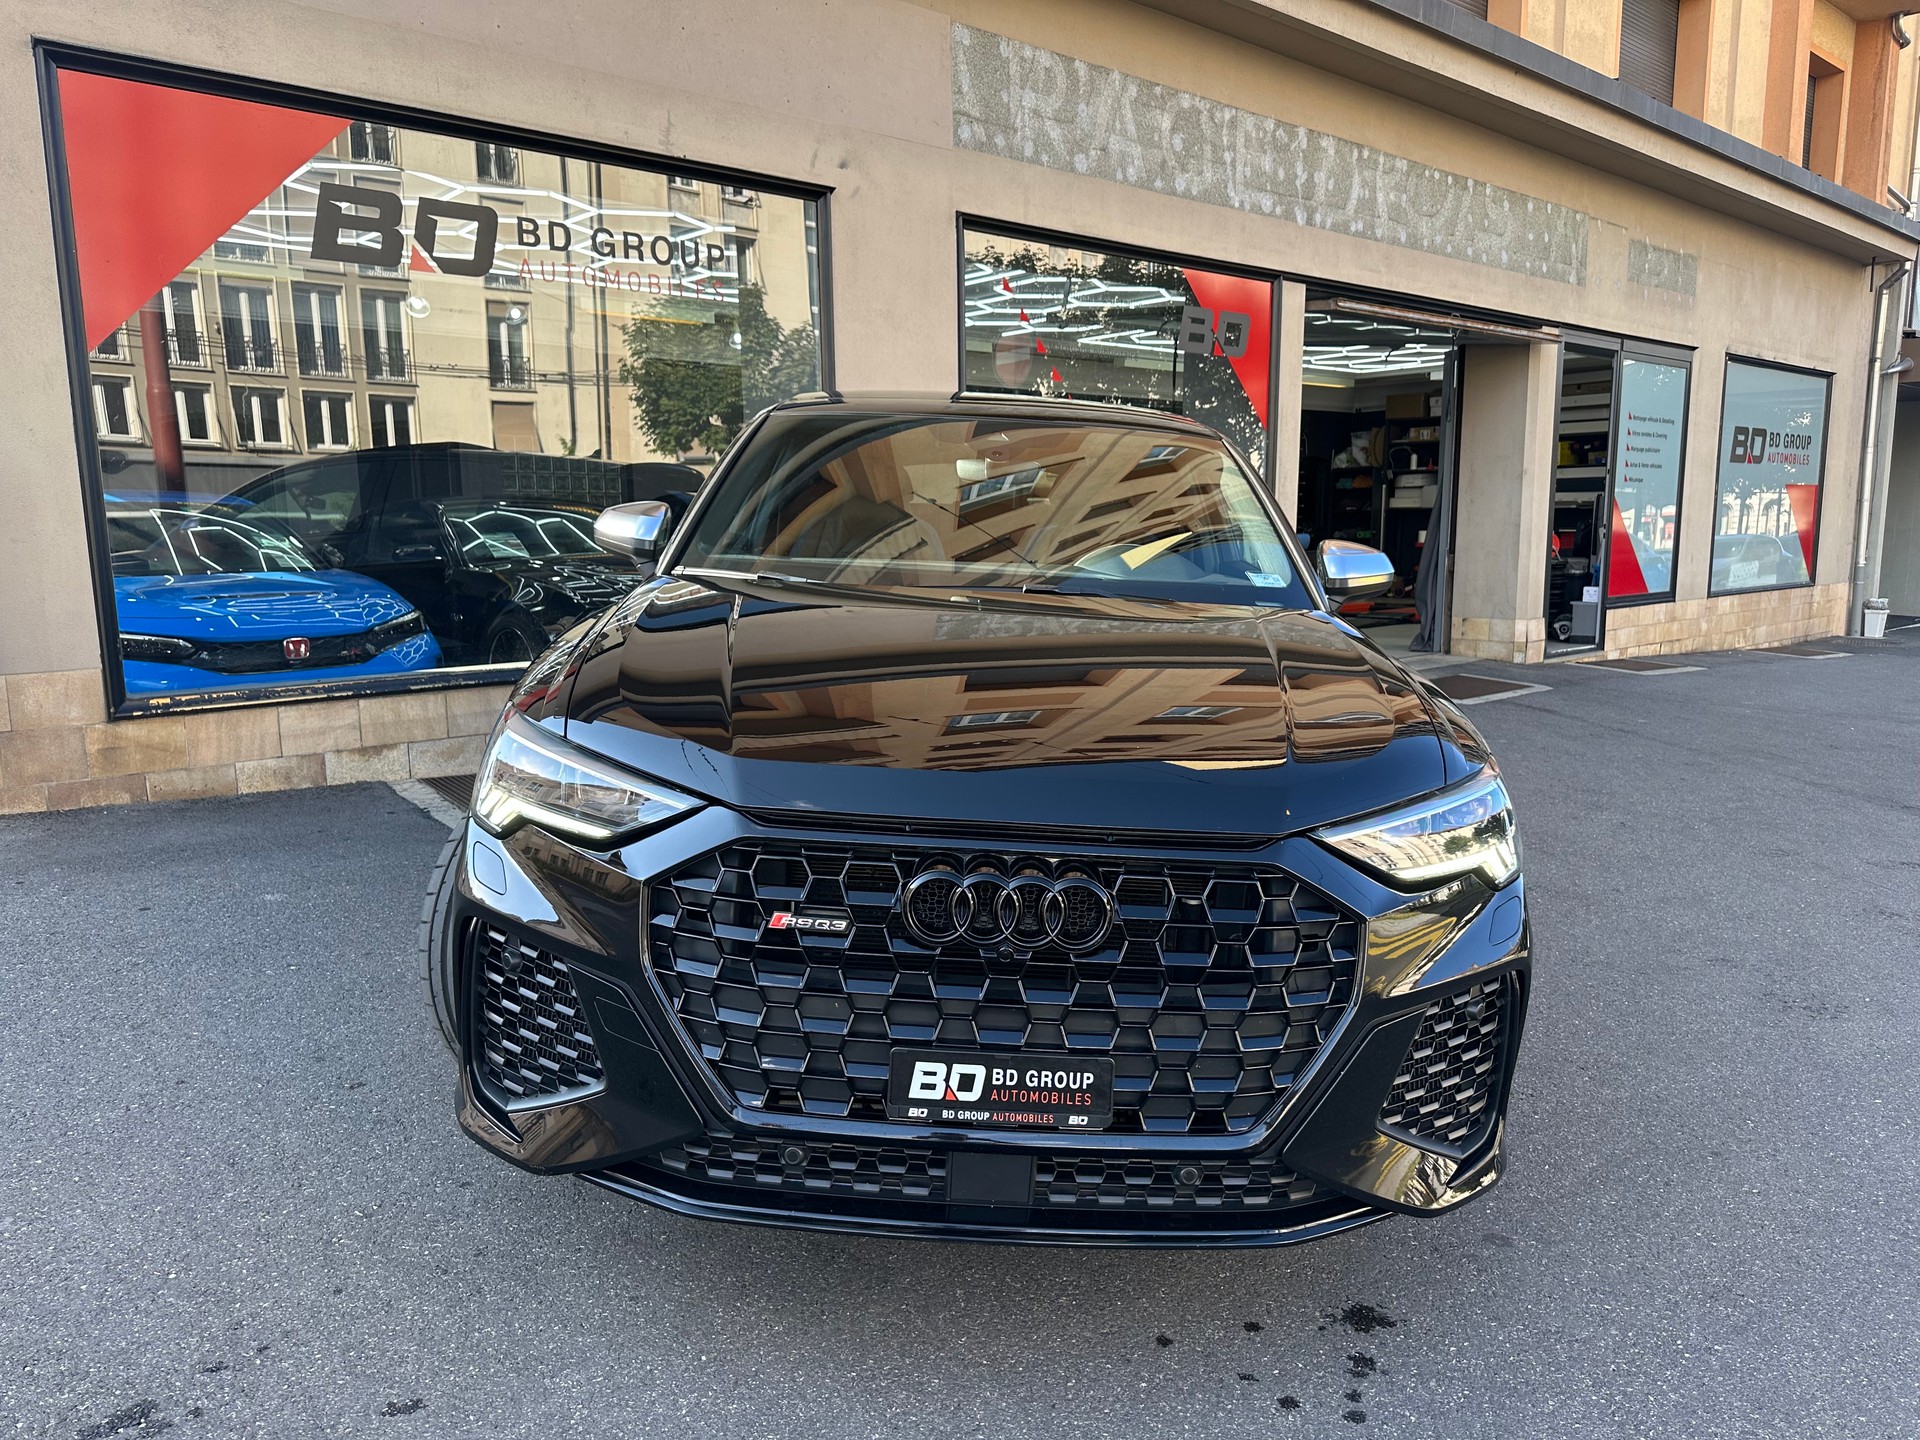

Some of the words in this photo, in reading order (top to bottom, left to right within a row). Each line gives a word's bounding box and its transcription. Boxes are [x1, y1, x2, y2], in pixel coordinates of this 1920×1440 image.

[310, 182, 498, 277] BD
[517, 216, 571, 251] BD
[591, 227, 725, 272] GROUP
[1179, 306, 1251, 358] BD
[1729, 426, 1767, 464] BD
[1769, 432, 1780, 448] BD
[1783, 433, 1811, 450] GROUP
[1768, 452, 1810, 465] AUTOMOBILES
[908, 1061, 987, 1102] BD
[992, 1068, 1018, 1086] BD
[1025, 1070, 1094, 1089] GROUP
[991, 1089, 1092, 1105] AUTOMOBILES
[942, 1110, 955, 1119] BD
[957, 1111, 990, 1121] GROUP
[992, 1112, 1054, 1123] AUTOMOBILES
